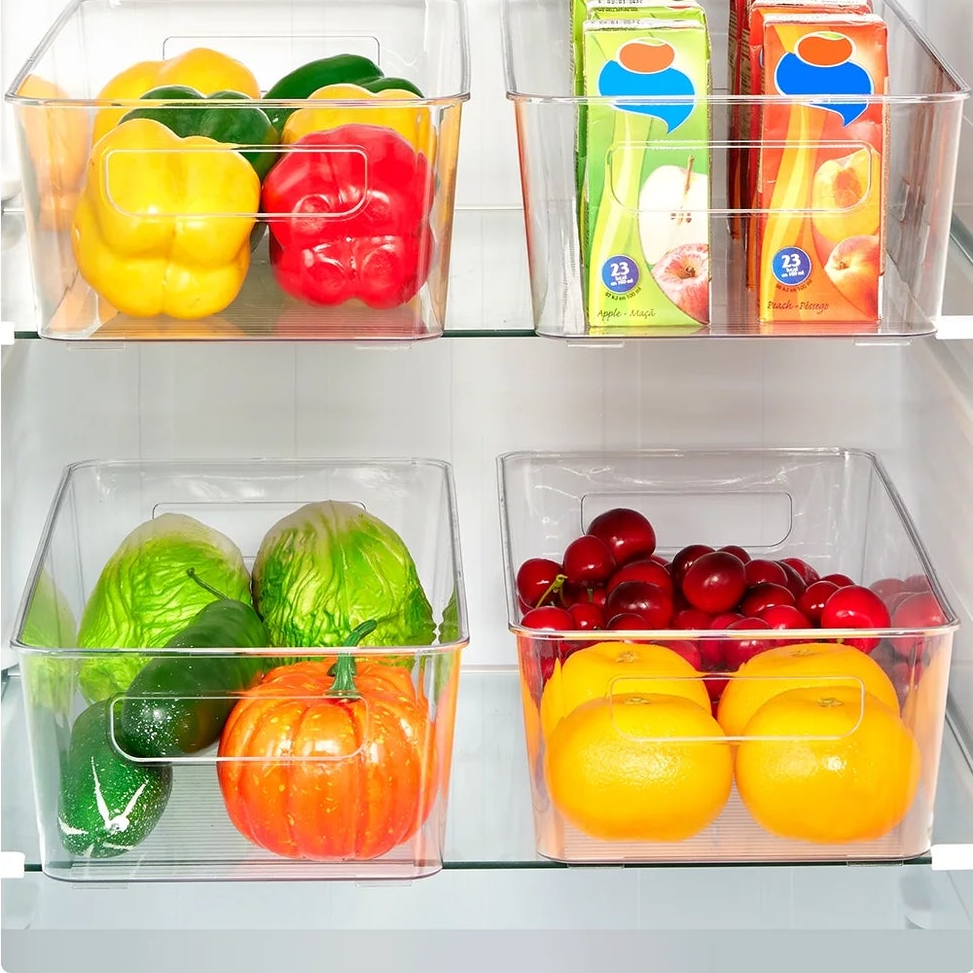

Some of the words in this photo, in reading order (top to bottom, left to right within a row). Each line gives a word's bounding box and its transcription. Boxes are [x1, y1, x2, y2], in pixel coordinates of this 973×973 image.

[781, 253, 801, 269] 23
[610, 261, 630, 277] 23
[767, 300, 795, 310] Peach
[597, 308, 622, 322] Apple
[629, 308, 657, 320] Maçã
